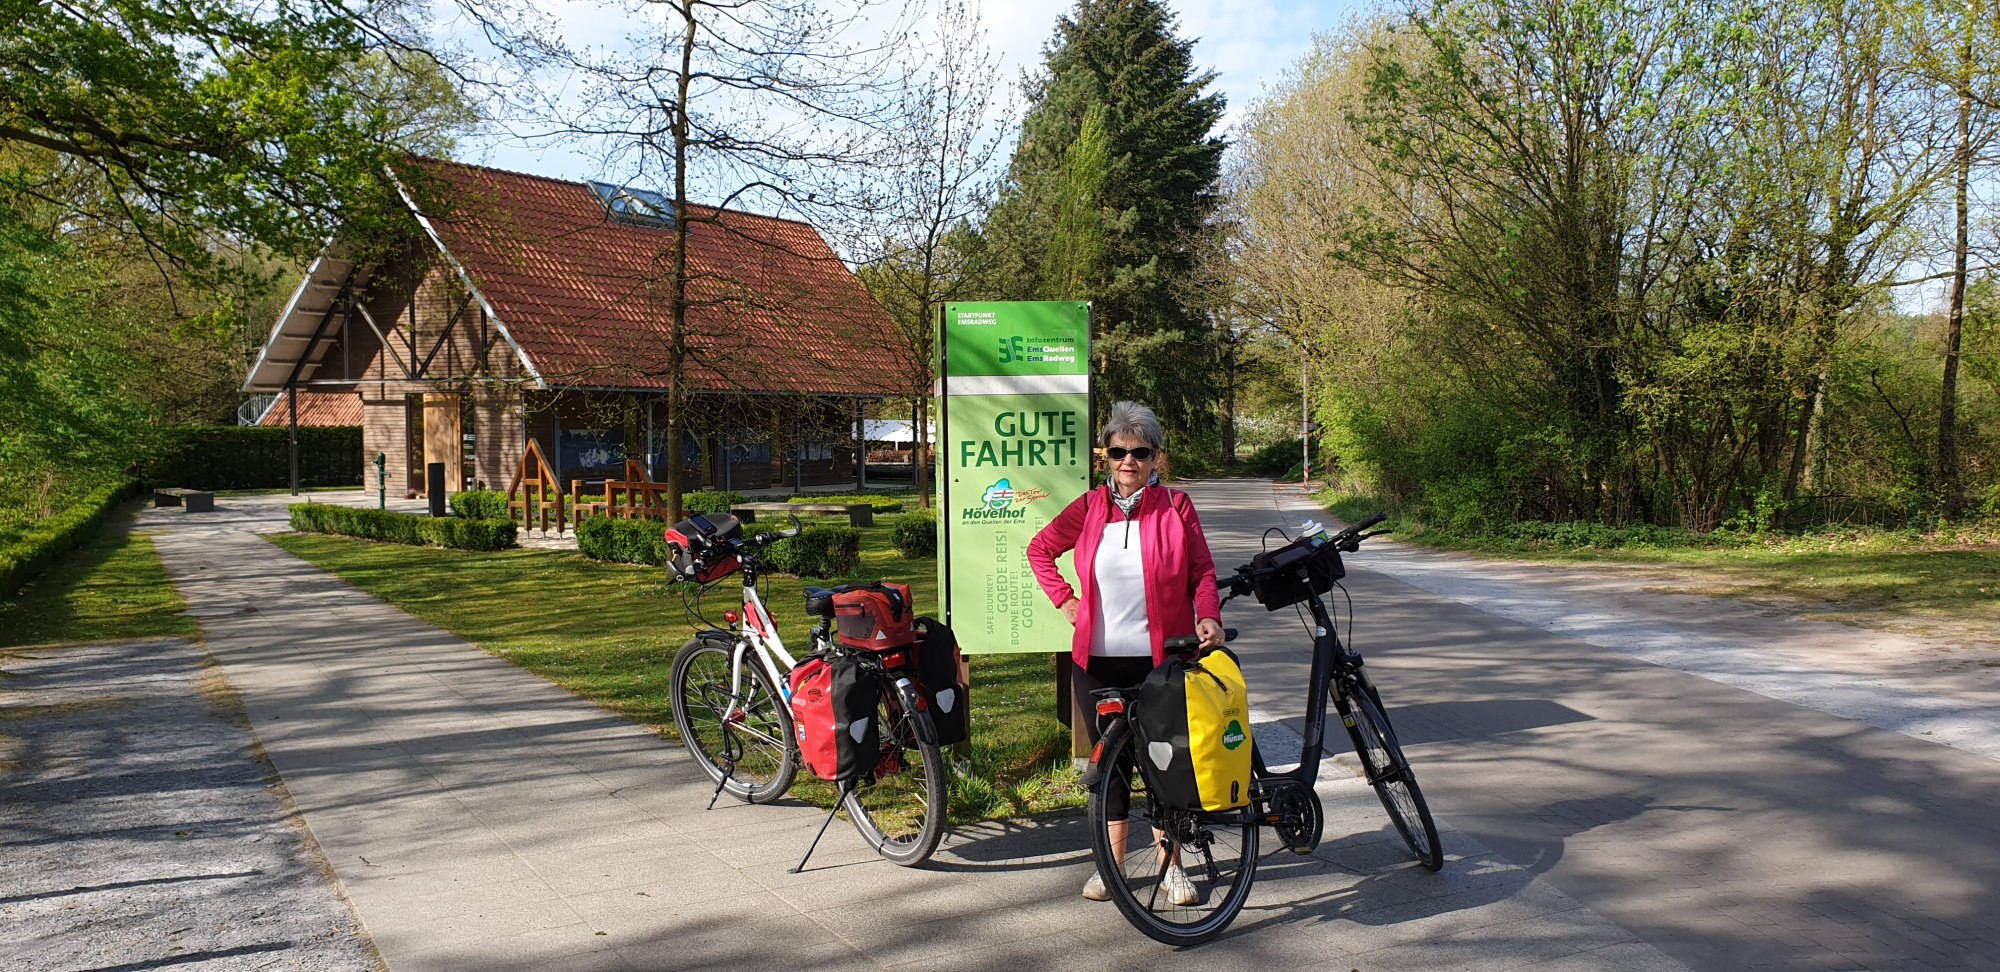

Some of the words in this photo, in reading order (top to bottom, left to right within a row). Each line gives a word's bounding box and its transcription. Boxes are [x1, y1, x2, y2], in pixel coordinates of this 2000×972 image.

[1027, 355, 1075, 363] EmsRadweg
[995, 412, 1076, 437] GUTE
[961, 437, 1076, 468] FAHRT!
[962, 507, 1026, 519] Hövelhof
[996, 531, 1007, 563] REIS!
[996, 567, 1008, 613] GOEDE
[1009, 571, 1018, 607] ROUTE!
[1021, 582, 1033, 628] GOEDE
[1011, 610, 1020, 645] BONNE
